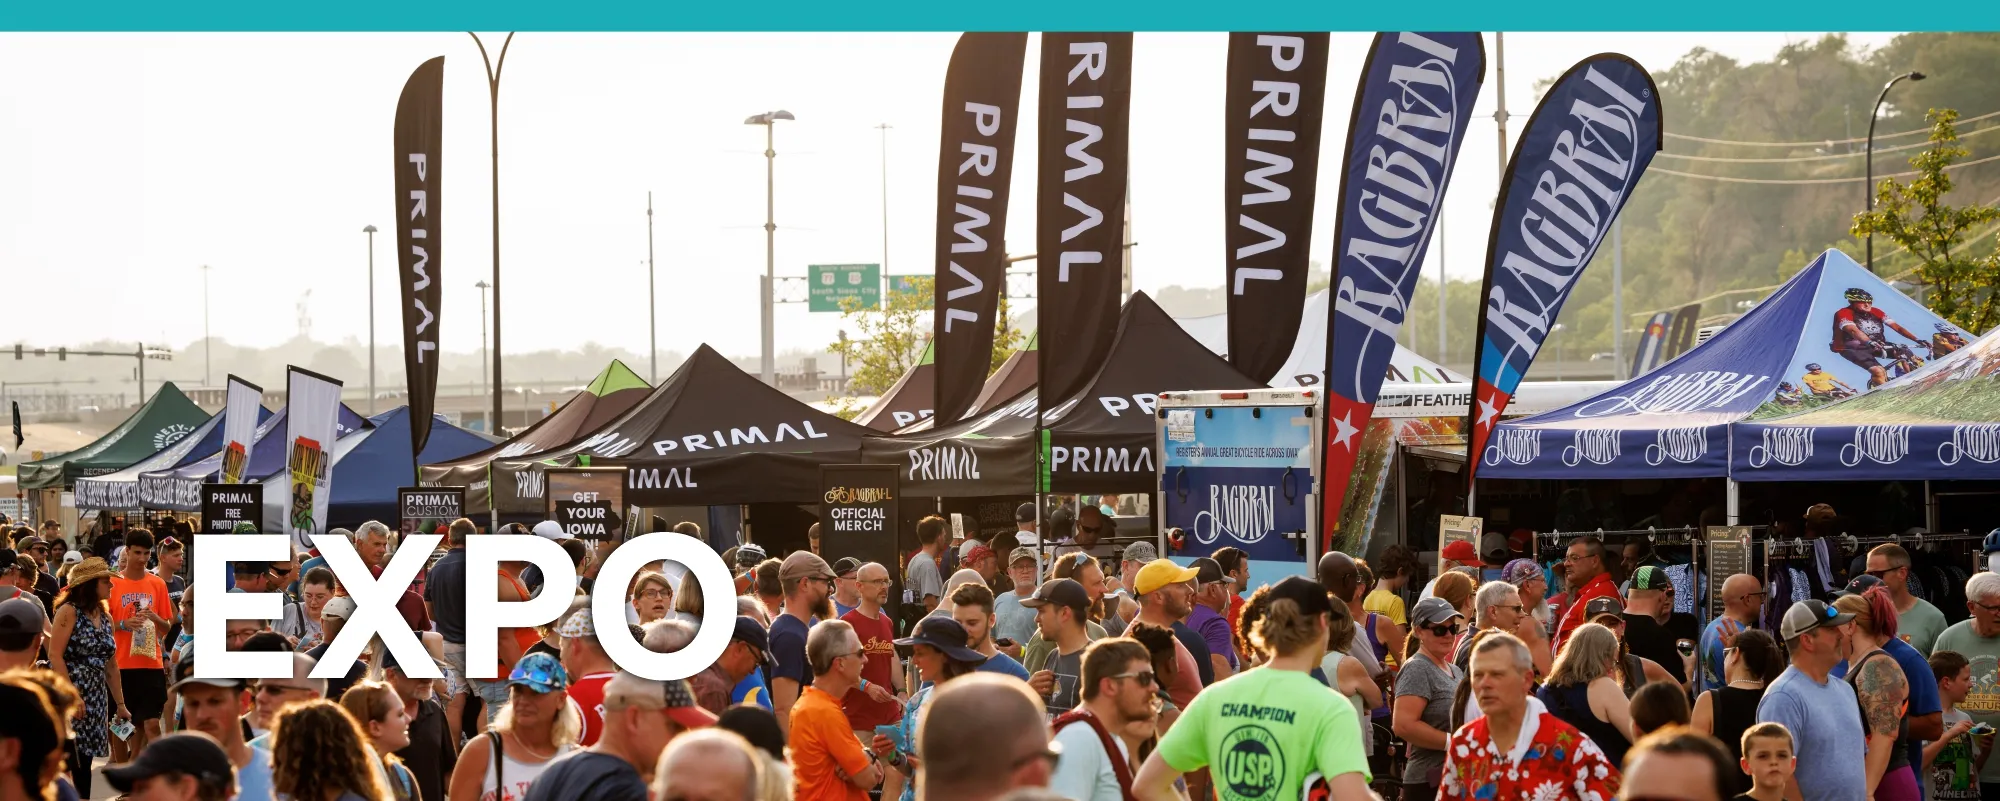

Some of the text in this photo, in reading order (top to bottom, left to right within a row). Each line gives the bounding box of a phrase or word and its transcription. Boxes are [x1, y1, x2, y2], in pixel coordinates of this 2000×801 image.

[1058, 41, 1108, 283] RIMAL
[1233, 34, 1305, 296] PRIMAL
[944, 101, 1001, 333] PRIMAL
[1335, 32, 1459, 404] RAGBRAI
[1487, 65, 1649, 388] RAGBRAI
[408, 153, 436, 364] PRIMAL
[862, 287, 877, 295] City
[1575, 371, 1770, 418] RAGBRAI
[653, 420, 828, 456] PRIMAL
[1484, 429, 1542, 466] RAGBRAI
[1562, 427, 1623, 466] RAGBRAI
[1645, 426, 1708, 466] RAGBRAI
[1749, 427, 1816, 468] RAGBRAI
[1840, 425, 1912, 467] RAGBRAI
[1938, 424, 2000, 466] RAGBR
[909, 446, 981, 480] PRIMAL
[1051, 446, 1155, 472] PRIMA
[1200, 446, 1219, 459] ANNUAL
[1220, 446, 1234, 459] GREAT
[1234, 446, 1253, 459] BICYCLE
[1254, 446, 1265, 459] RIDE
[1265, 446, 1285, 459] ACROSS
[515, 471, 535, 498] PRIM
[628, 467, 698, 489] IMAL
[75, 480, 140, 508] BIG GROVE BREWERY
[141, 477, 204, 507] BIG GROVE BREWER
[212, 493, 254, 504] PRIMAL
[406, 494, 459, 506] PRIMAL
[572, 491, 600, 504] GET
[212, 519, 232, 530] PHOTO
[225, 508, 241, 519] FREE
[406, 506, 459, 516] CUSTOM
[566, 507, 606, 519] YOUR
[831, 507, 886, 519] OFFICIAL
[1194, 484, 1276, 545] RAGBRAI
[566, 523, 606, 535] IOWA
[834, 520, 883, 531] MERCH
[1710, 530, 1729, 539] Pricing:
[583, 538, 600, 551] N!
[1221, 703, 1296, 725] CHAMPION
[1960, 701, 2000, 710] CENTUR
[1227, 750, 1273, 788] USP
